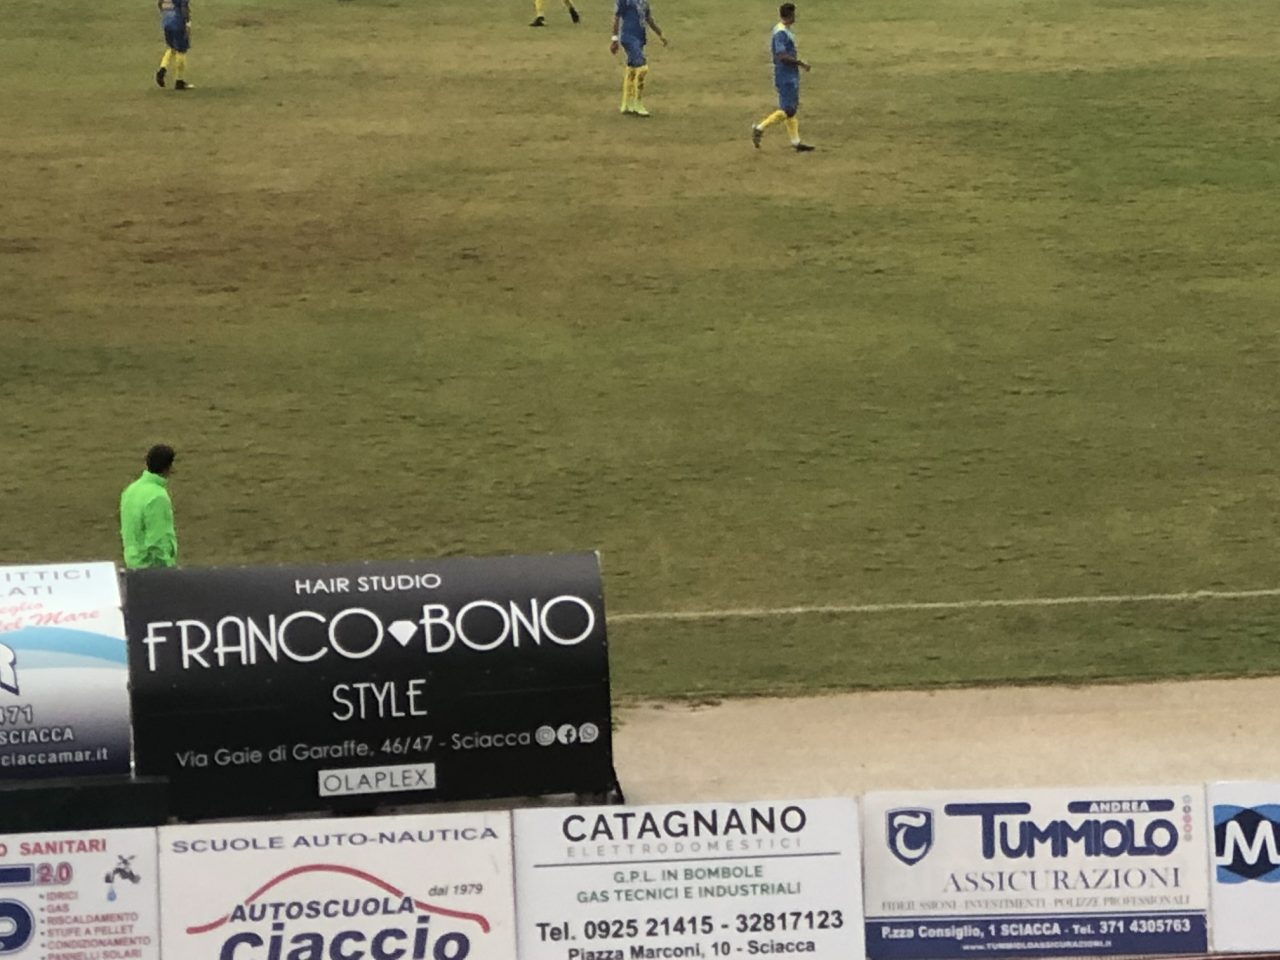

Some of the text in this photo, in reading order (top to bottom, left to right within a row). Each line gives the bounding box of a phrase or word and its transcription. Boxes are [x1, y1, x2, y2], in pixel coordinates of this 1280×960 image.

[5, 569, 91, 583] ITTICI
[295, 573, 442, 595] HAIR STUDIO
[0, 585, 53, 599] ATI
[143, 594, 595, 671] FRANCO BONO
[331, 679, 428, 721] STYLE
[0, 727, 74, 745] SCIACCA
[176, 751, 208, 769] Via
[214, 746, 262, 767] Gaie
[269, 744, 287, 763] di
[381, 734, 433, 754] 46/47
[451, 730, 531, 751] Sciacca
[322, 768, 428, 793] OLAPLEX
[1089, 800, 1150, 813] ANDREA
[562, 805, 807, 842] CATAGNANO
[19, 838, 107, 856] SANITARI
[172, 826, 499, 854] SCUOLE AUTO-NAUTICA
[566, 838, 802, 858] ELETTRODOMESTICI
[36, 861, 74, 886] 2.0
[661, 869, 678, 882] IN
[683, 865, 764, 881] BOMBOLE
[943, 866, 1181, 893] ASSICURAZIONI
[452, 883, 483, 896] 1979
[576, 881, 801, 904] GAS TECNICI E INDUSTRIALI
[46, 904, 70, 913] GAS
[228, 896, 415, 924] AUTOSCUOLA
[47, 924, 134, 938] STUFE A PELLET
[536, 920, 576, 942] Tel.
[584, 918, 639, 940] 0925
[646, 915, 714, 938] 21415
[735, 909, 844, 934] 32817123
[881, 925, 915, 940] P.zza
[918, 923, 985, 941] Consiglio,
[988, 923, 996, 937] 1
[1000, 922, 1061, 938] SCIACCA
[1072, 923, 1095, 936] Tel.
[1099, 920, 1125, 935] 371
[1129, 918, 1191, 934] 4305763
[568, 946, 624, 960] Piazza
[630, 942, 706, 960] Marconi,
[712, 941, 731, 956] 10
[747, 939, 816, 955] Sciacca
